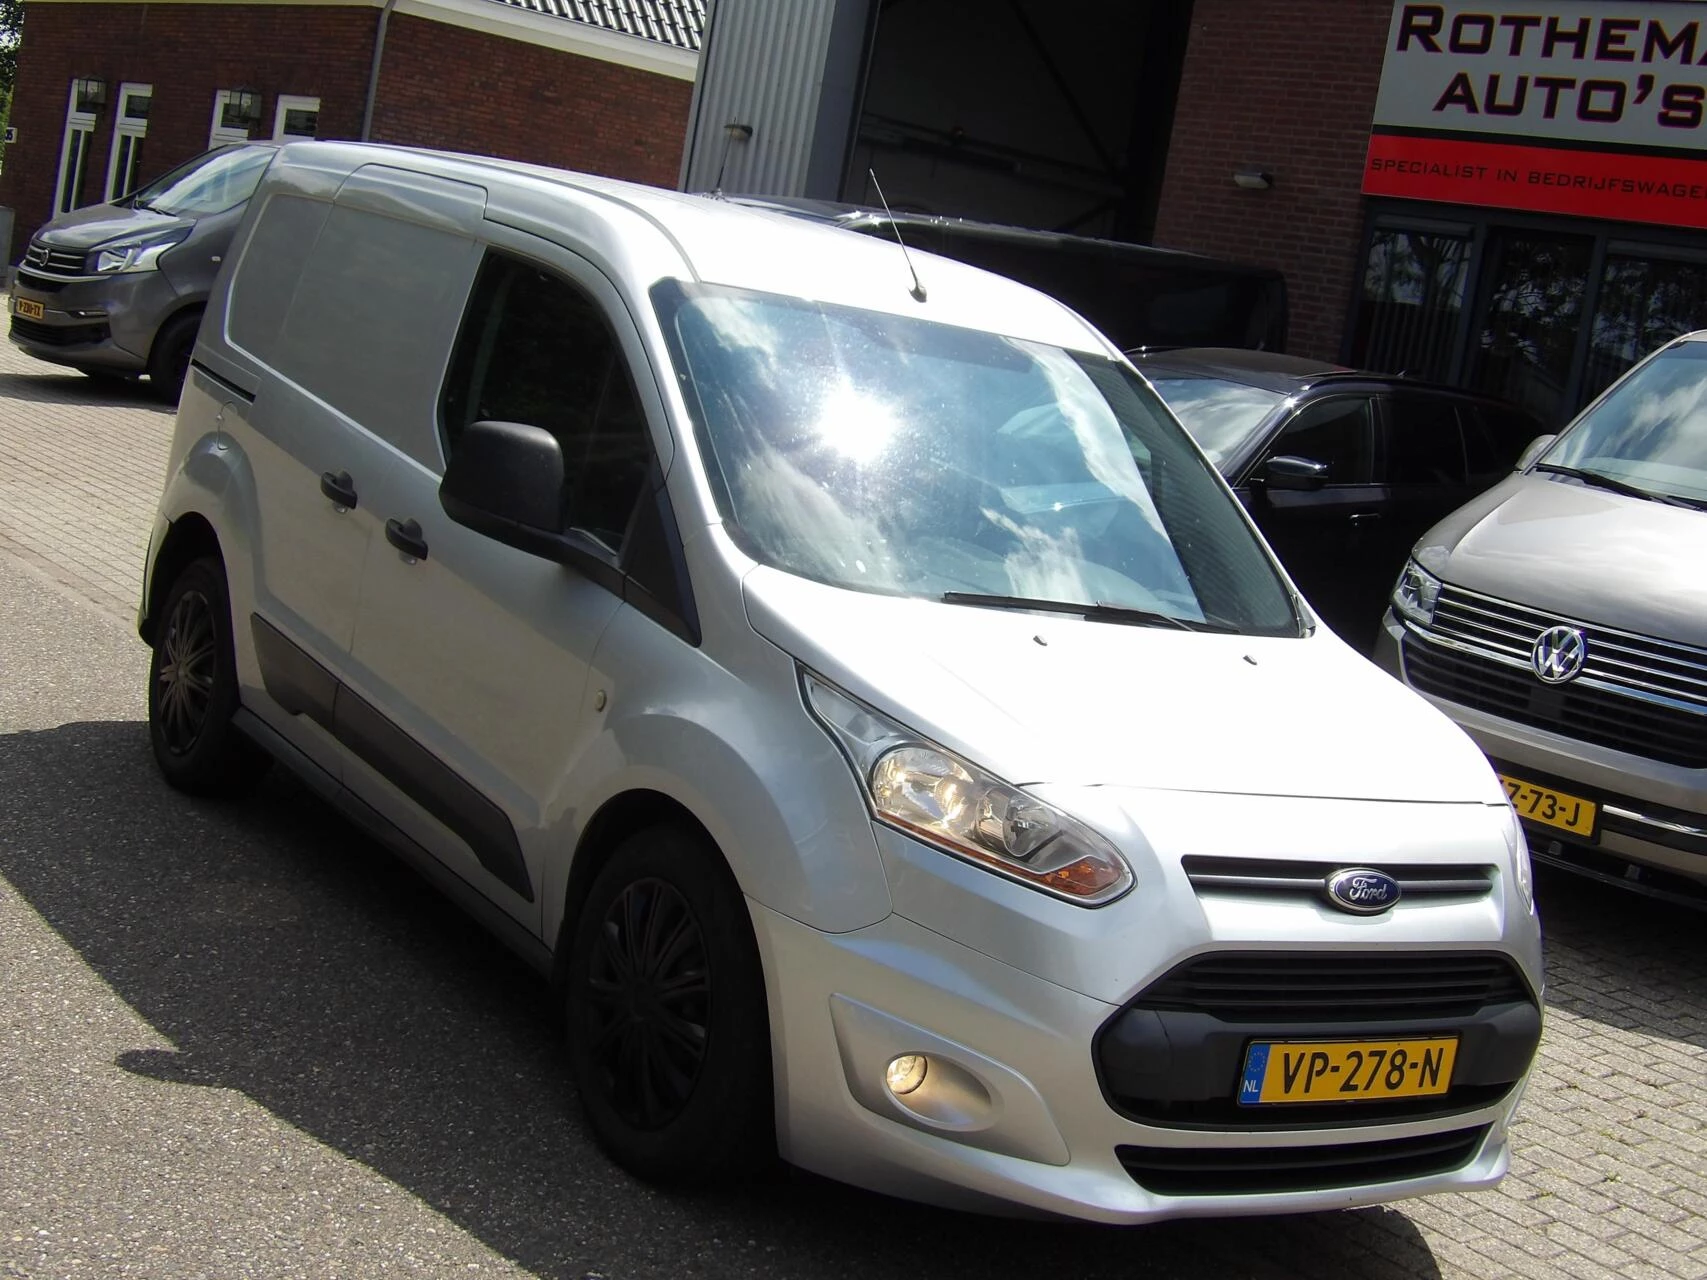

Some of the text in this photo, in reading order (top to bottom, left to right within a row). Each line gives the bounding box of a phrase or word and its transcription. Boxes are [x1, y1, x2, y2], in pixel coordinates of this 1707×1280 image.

[1396, 4, 1707, 66] ROTHEM
[1432, 72, 1705, 129] AUTO'S
[1371, 157, 1707, 200] SPECIALIST IN BEDRIJFSWAGE
[1349, 877, 1388, 901] Ford
[1243, 1047, 1444, 1094] NL VP-278-N
